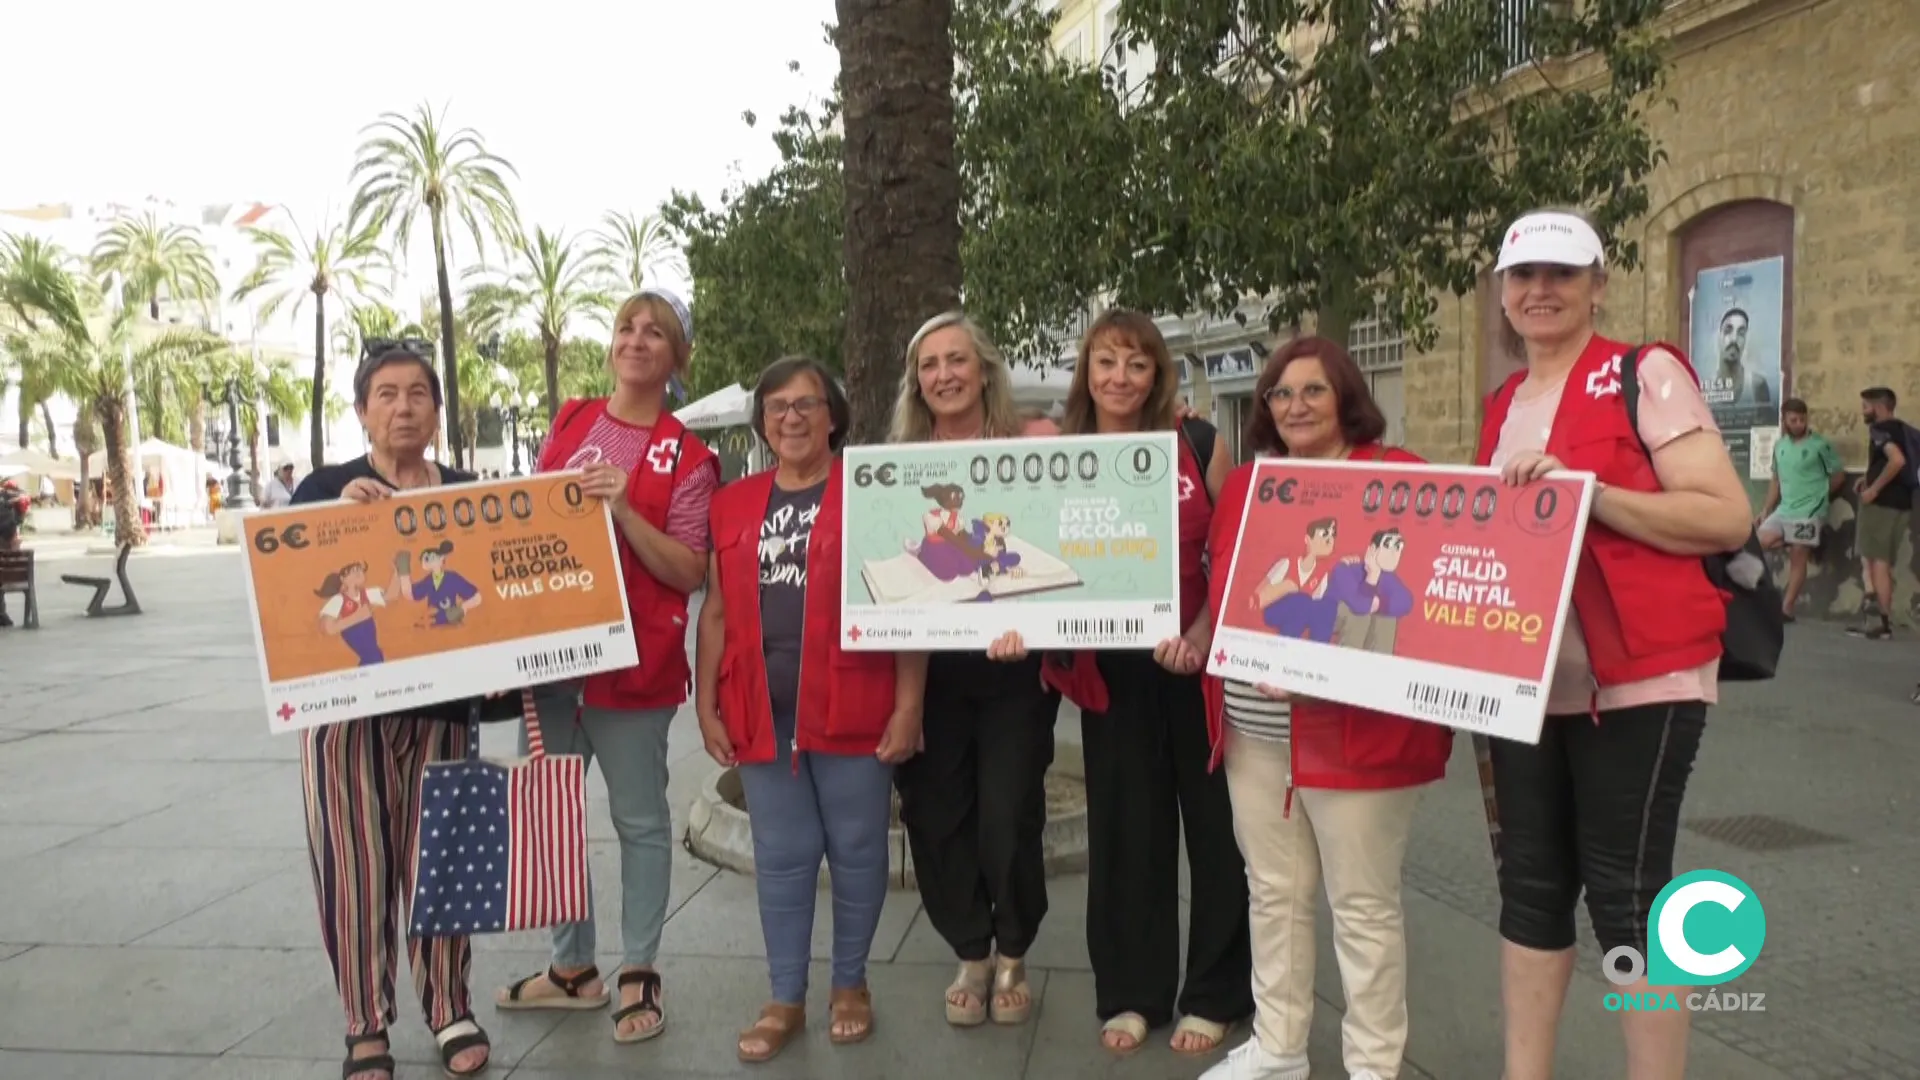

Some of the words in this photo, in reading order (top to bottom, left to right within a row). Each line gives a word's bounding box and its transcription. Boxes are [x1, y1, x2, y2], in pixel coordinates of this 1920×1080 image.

[1524, 224, 1547, 235] Cruz
[1550, 223, 1573, 236] Roja
[853, 461, 898, 488] 6€
[1258, 476, 1298, 505] 6€
[254, 523, 311, 555] 6€
[1059, 521, 1148, 539] ESCOLAR
[490, 539, 568, 566] FUTURO
[1440, 543, 1479, 557] CUIDAR
[1482, 547, 1496, 559] LA
[491, 555, 583, 582] LABORAL
[1432, 556, 1508, 583] SALUD
[495, 579, 545, 601] VALE
[549, 570, 594, 593] ORO
[1424, 576, 1517, 608] MENTAL
[866, 628, 889, 638] Cruz
[890, 627, 912, 639] Roja
[1422, 599, 1477, 628] VALE
[1482, 608, 1543, 643] ORO
[1230, 654, 1250, 669] Cruz
[1251, 657, 1270, 673] Roja
[300, 701, 328, 714] Cruz
[331, 694, 358, 708] Roja
[374, 687, 403, 700] Sorteo
[404, 685, 415, 694] de
[418, 681, 434, 692] Oro
